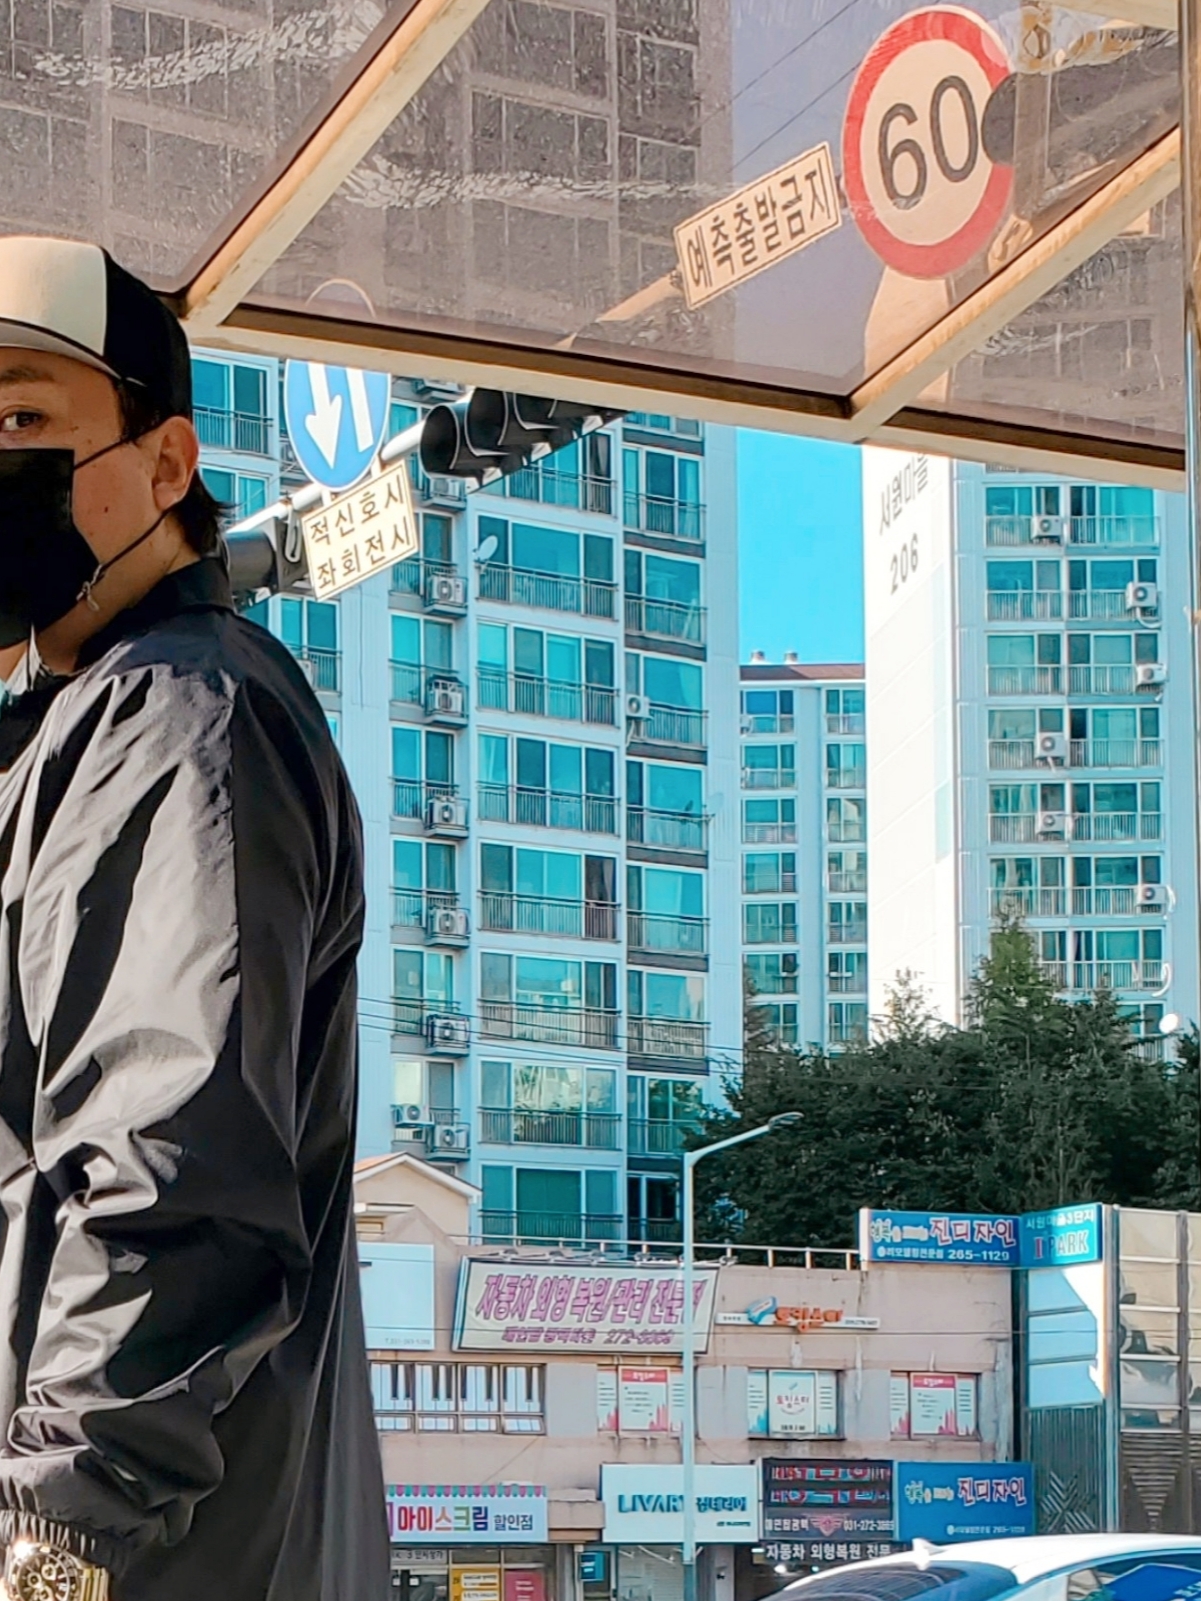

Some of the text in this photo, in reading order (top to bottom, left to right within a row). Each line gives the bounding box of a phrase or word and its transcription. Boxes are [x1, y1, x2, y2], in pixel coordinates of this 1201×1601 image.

[877, 74, 979, 211] 60
[686, 157, 832, 288] 예측출발금지
[310, 474, 404, 546] 적신호시
[316, 515, 410, 590] 좌회전시
[889, 532, 919, 596] 206
[929, 1216, 1017, 1247] 진디자인
[475, 1274, 538, 1322] 자동차
[530, 1275, 579, 1322] 외형
[618, 1494, 684, 1513] LIVAR
[957, 1477, 1028, 1506] 진디자인
[397, 1505, 489, 1532] 아이스크림
[493, 1514, 534, 1532] 할인점
[766, 1543, 806, 1561] 자동차
[810, 1543, 861, 1561] 외형복원
